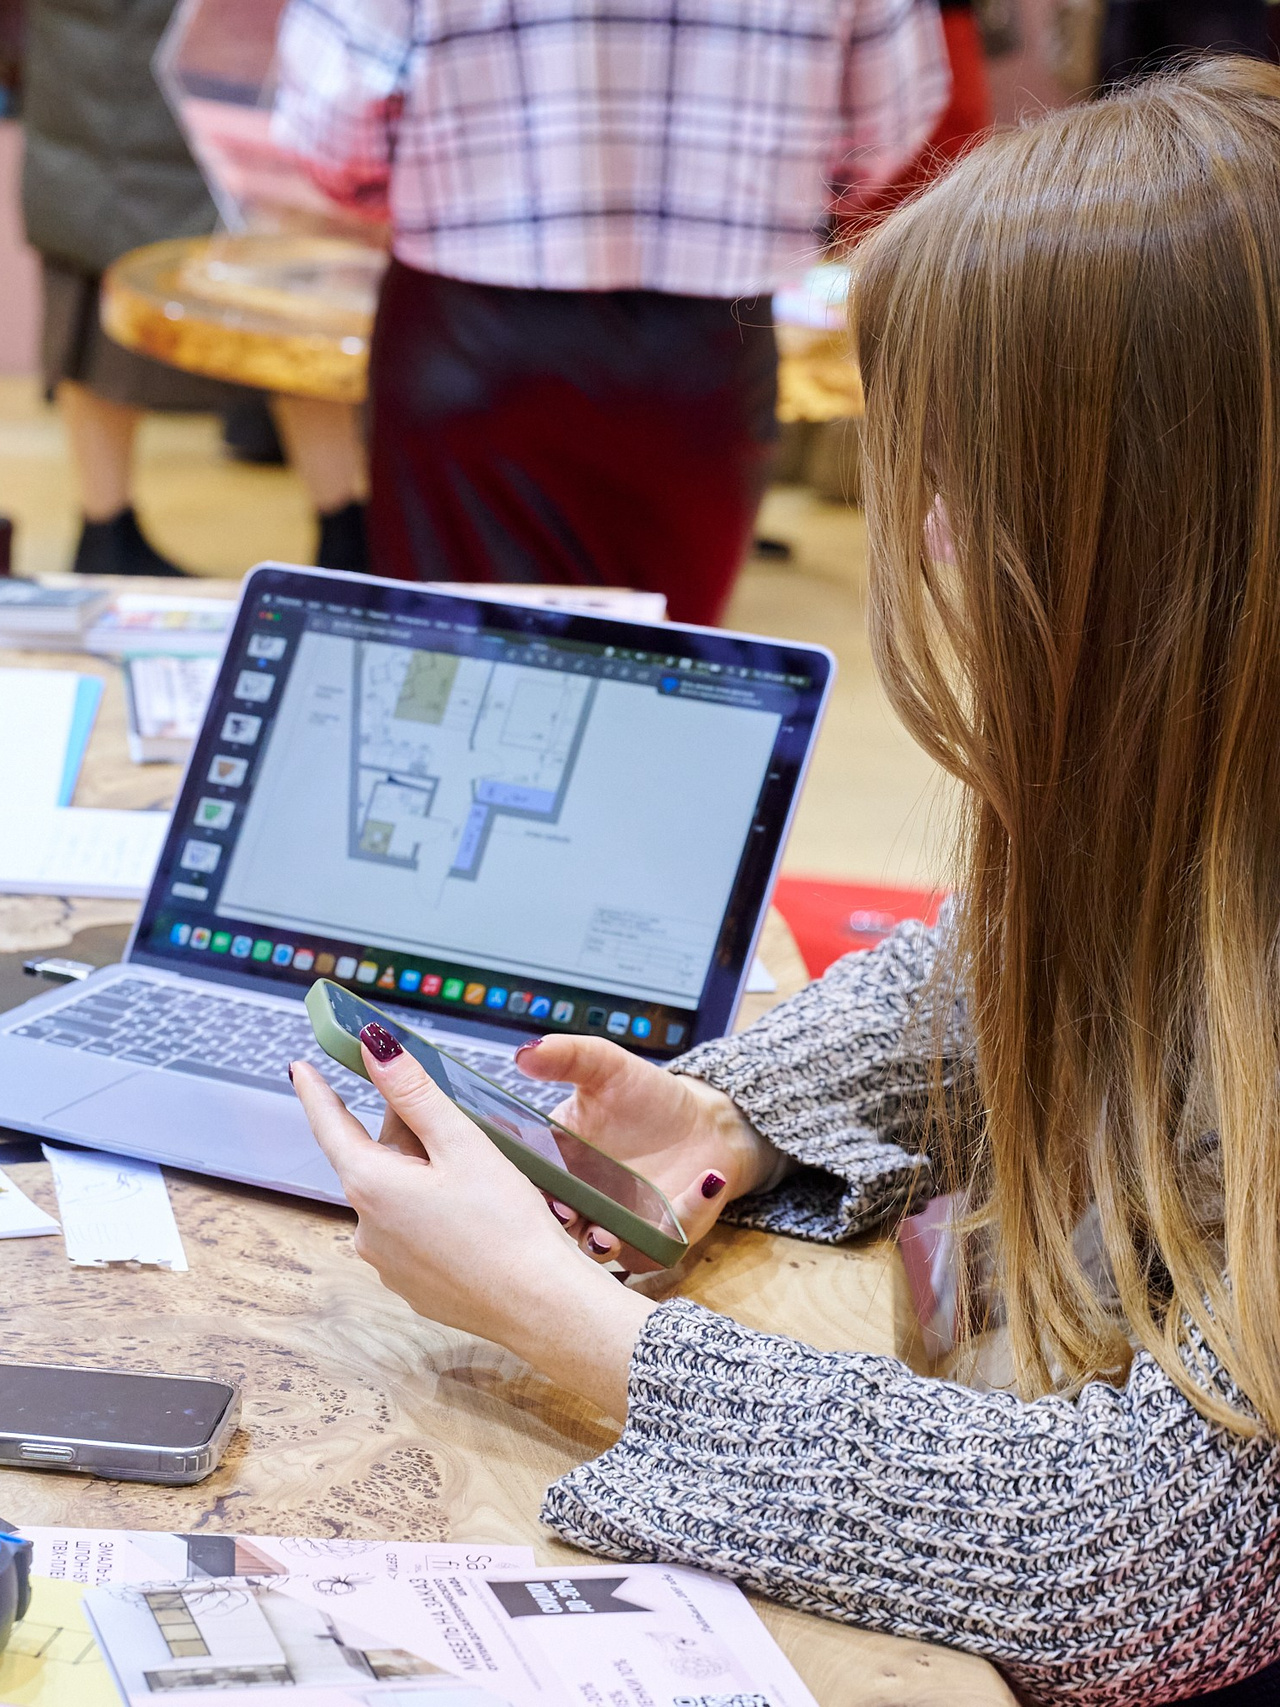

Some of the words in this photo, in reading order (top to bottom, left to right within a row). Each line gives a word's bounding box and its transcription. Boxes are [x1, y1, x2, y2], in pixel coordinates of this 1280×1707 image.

[409, 1577, 443, 1609] ЗАКАЗ
[524, 1582, 564, 1614] СКИДКИ
[431, 1608, 454, 1625] НА
[443, 1626, 482, 1671] МЕБЕЛЬ
